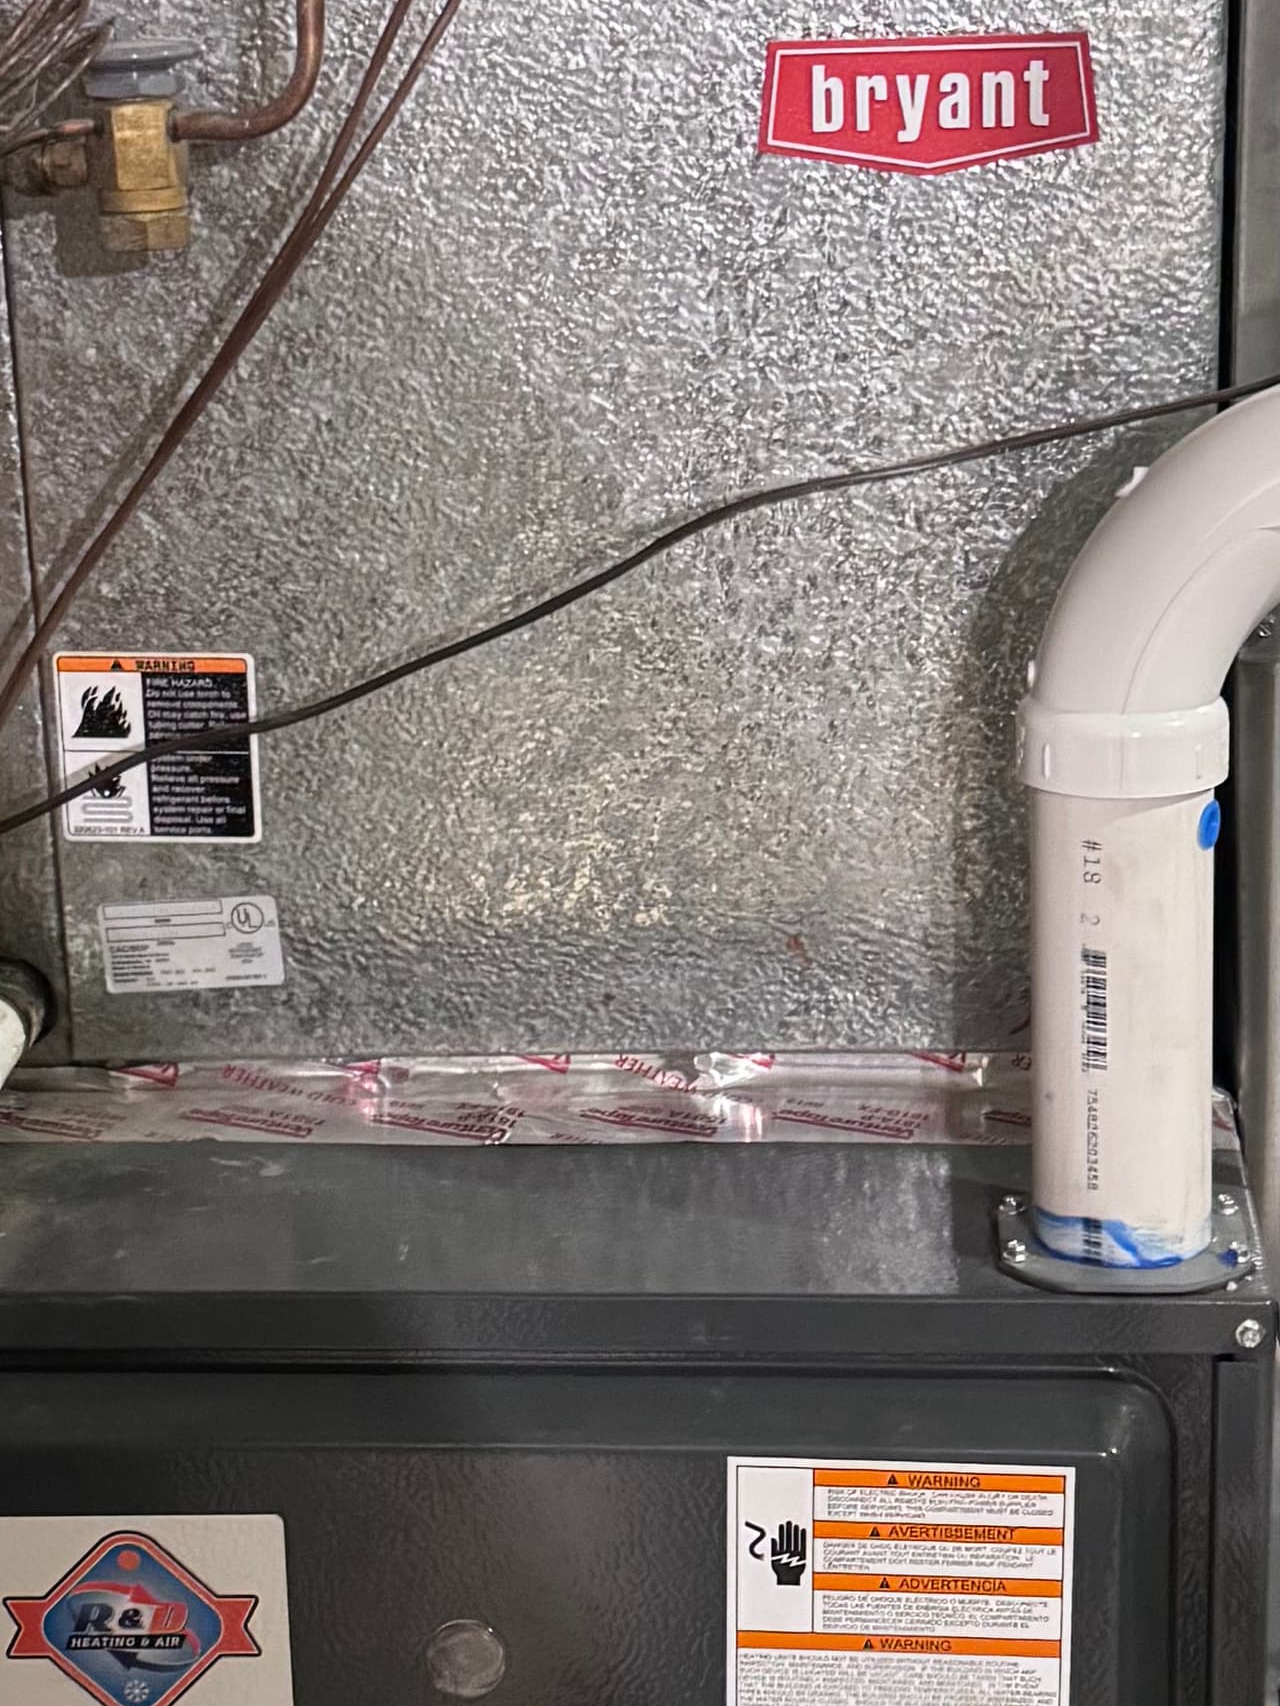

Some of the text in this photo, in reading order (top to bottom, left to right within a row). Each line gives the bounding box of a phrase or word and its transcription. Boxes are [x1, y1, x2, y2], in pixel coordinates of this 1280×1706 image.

[811, 60, 1049, 143] bryant
[135, 660, 195, 671] WARNING
[908, 1474, 980, 1488] WARNING
[888, 1526, 1015, 1541] AVERTISSEMENT
[71, 1636, 135, 1648] HEATING
[154, 1636, 180, 1648] AIR
[880, 1639, 952, 1652] WARNING
